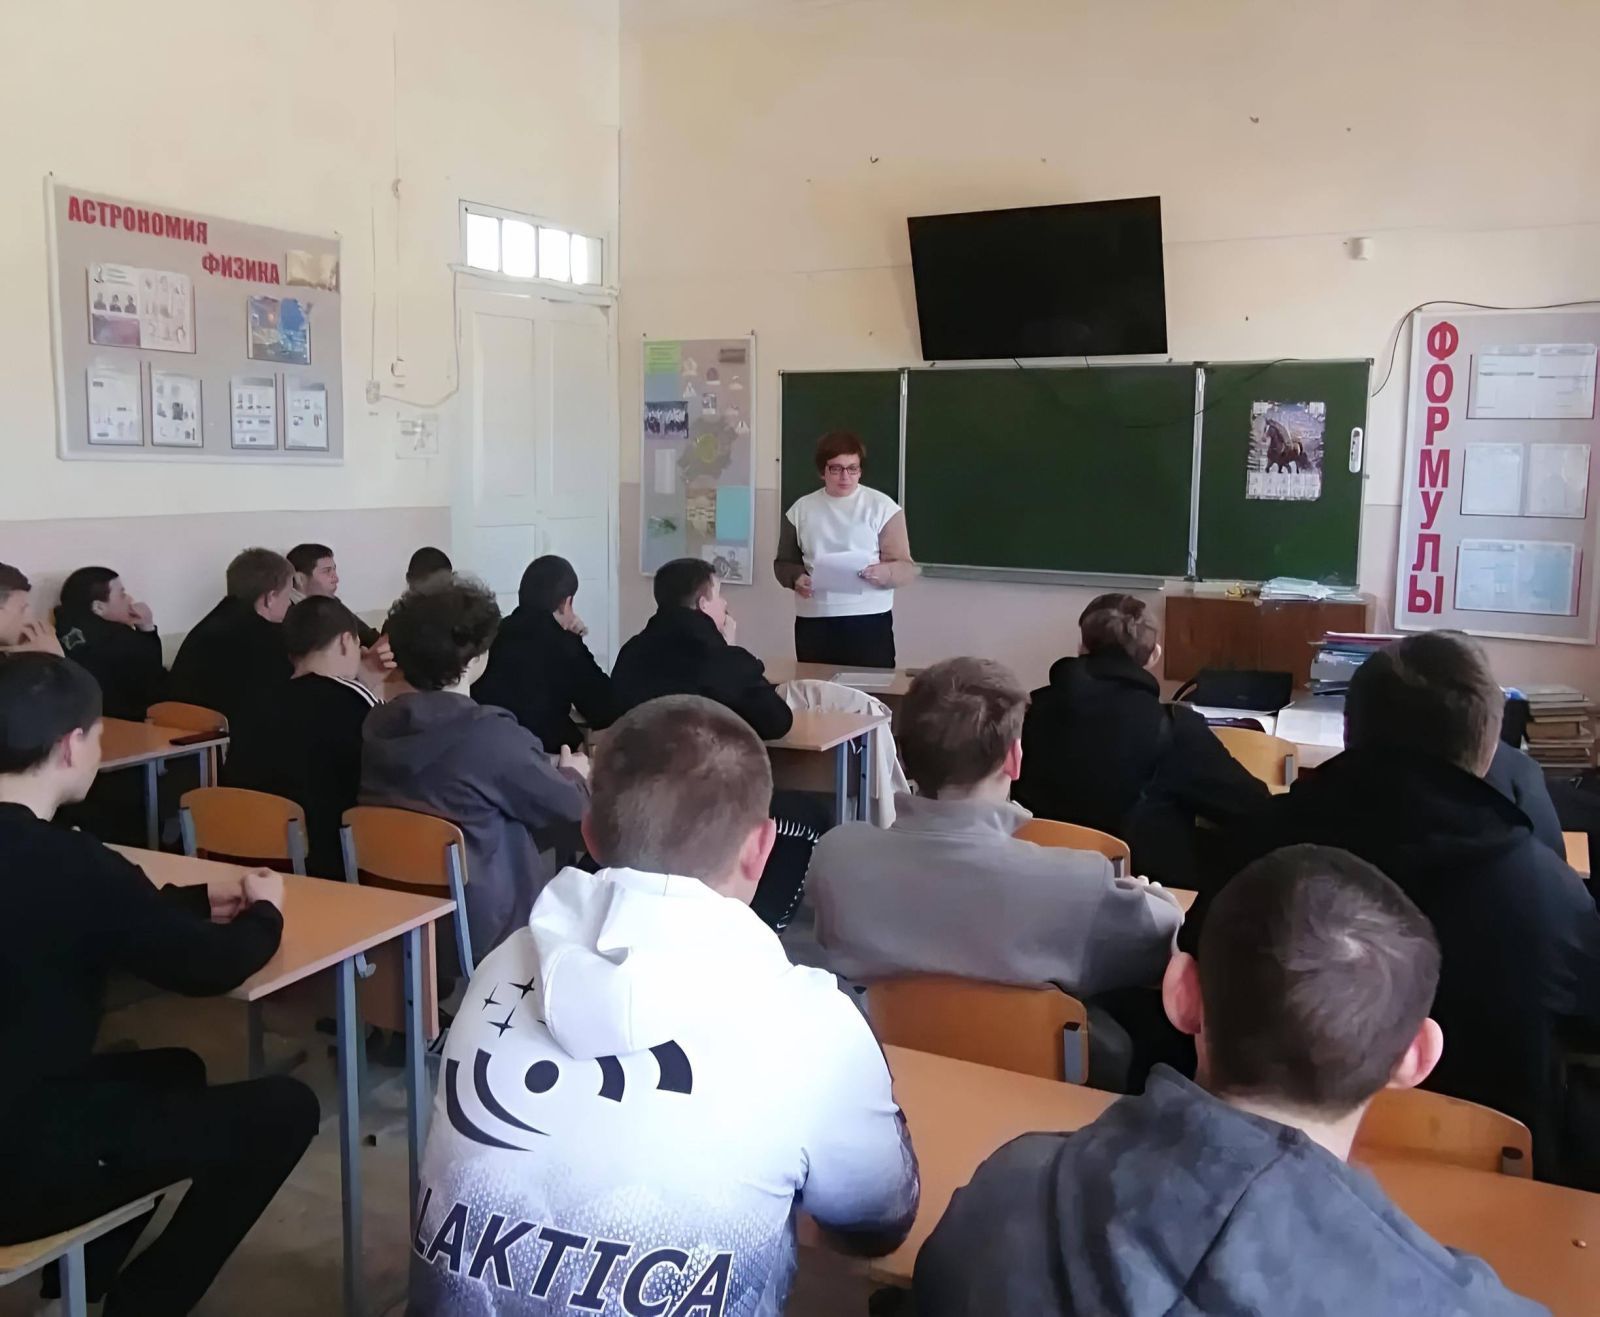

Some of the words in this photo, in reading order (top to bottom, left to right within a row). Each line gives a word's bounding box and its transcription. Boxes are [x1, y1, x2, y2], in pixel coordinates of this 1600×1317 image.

[68, 195, 208, 245] АСТРОНОМИЯ
[202, 252, 280, 286] ФИЗИКА
[1407, 321, 1460, 615] ФОРМУЛЫ
